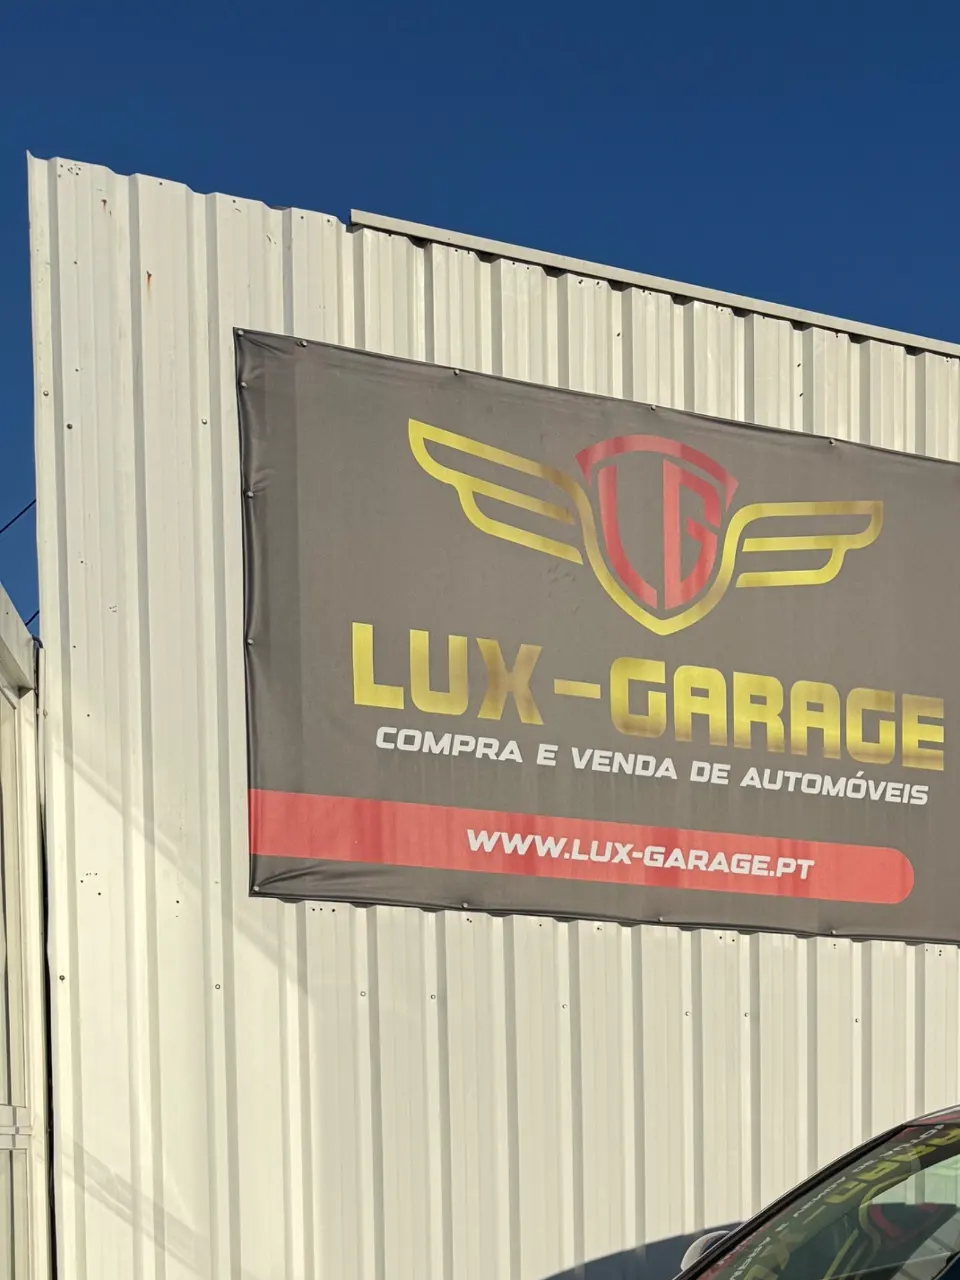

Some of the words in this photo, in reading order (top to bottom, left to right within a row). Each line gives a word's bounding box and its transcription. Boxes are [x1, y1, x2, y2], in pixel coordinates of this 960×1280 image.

[352, 622, 945, 771] LUX-GARAGE
[376, 726, 523, 763] COMPRA
[536, 743, 559, 767] E
[571, 747, 678, 780] VENDA
[690, 760, 732, 785] DE
[740, 770, 929, 805] AUTOMÓVEIS
[467, 828, 816, 881] WWW.LUX-GARAGE.PT
